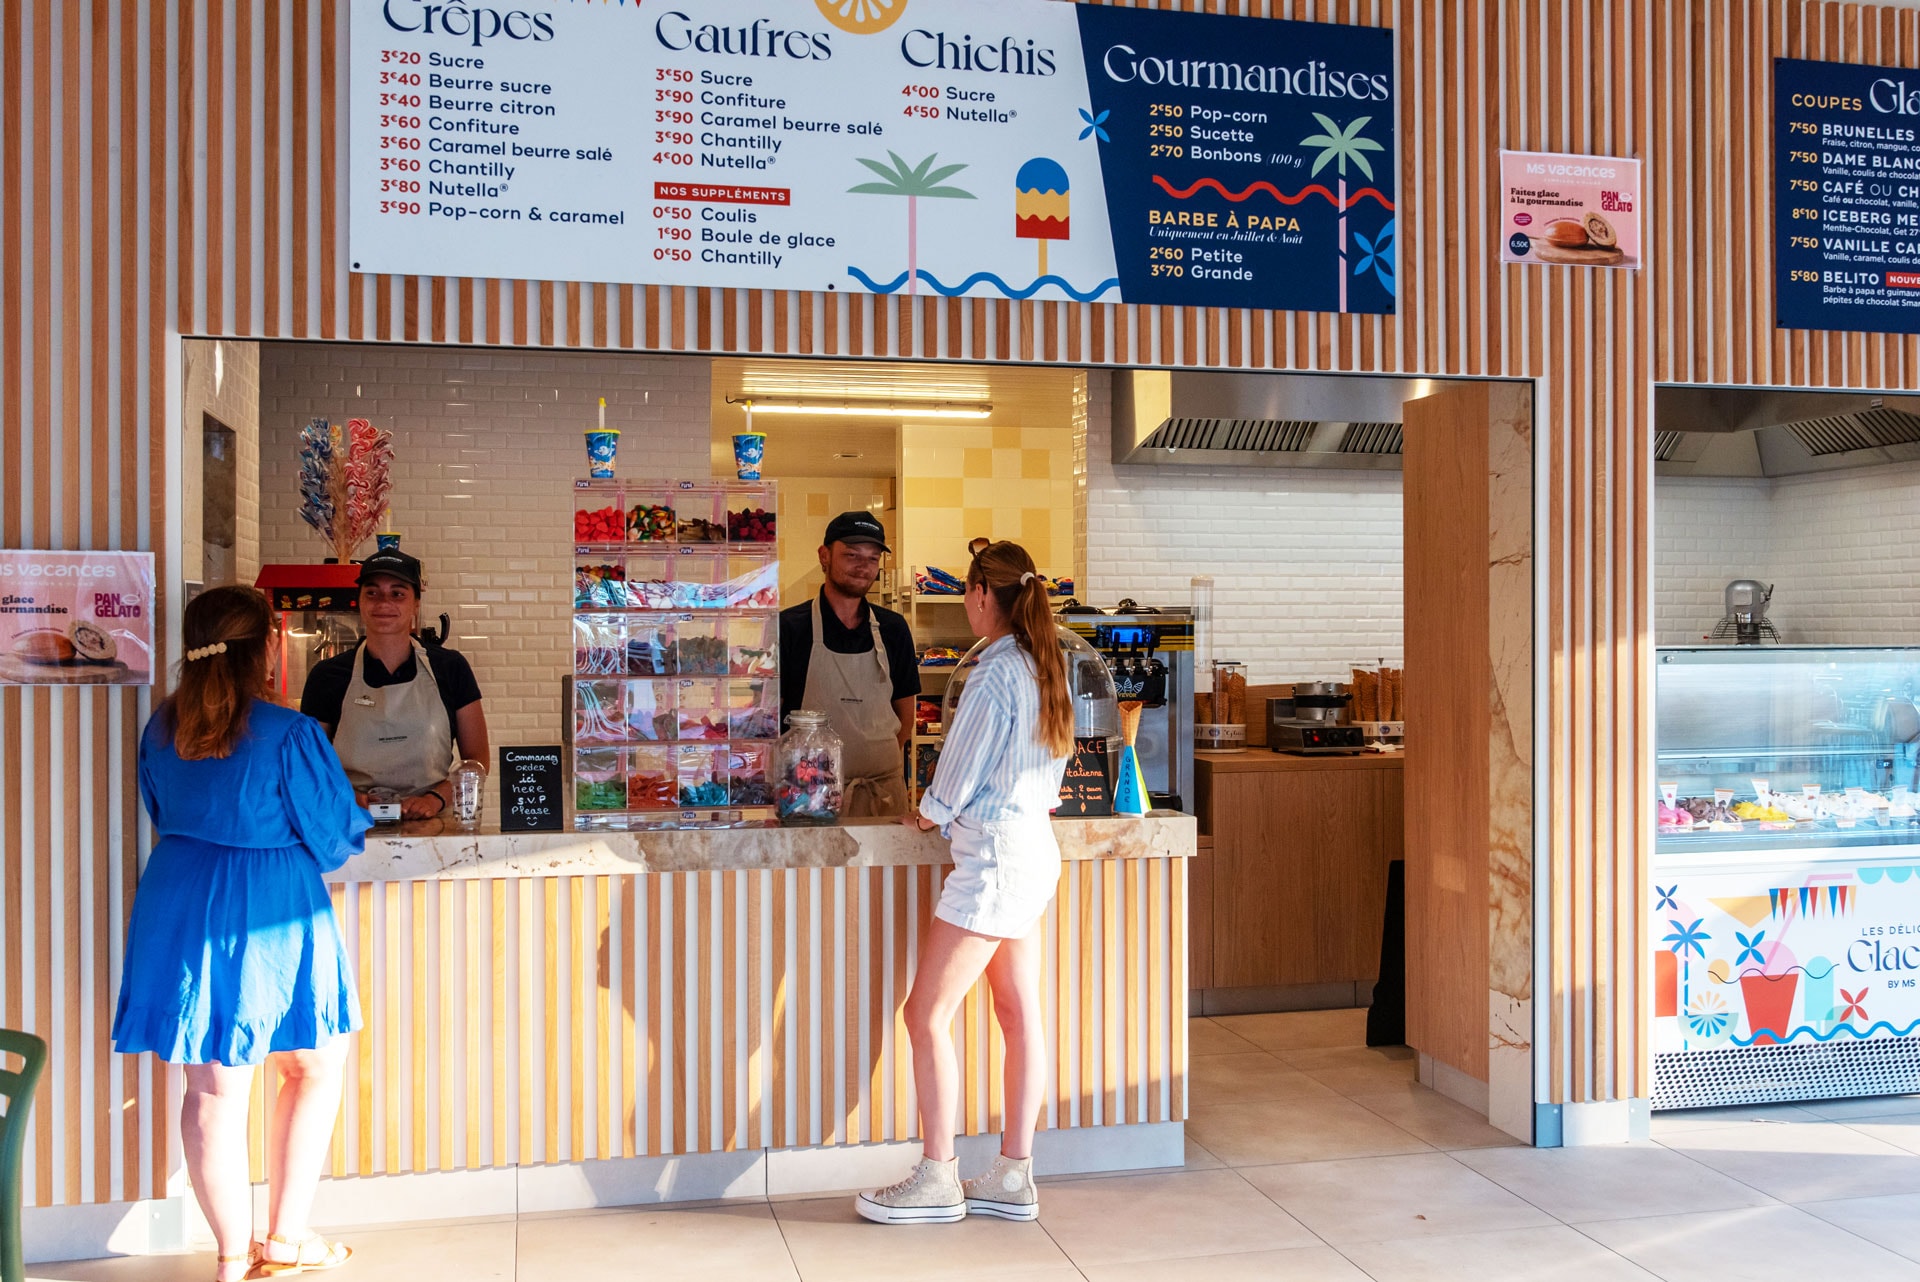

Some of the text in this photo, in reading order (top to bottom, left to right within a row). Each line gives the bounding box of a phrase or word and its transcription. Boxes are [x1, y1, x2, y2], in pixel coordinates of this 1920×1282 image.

[382, 0, 554, 47] Crêpes
[655, 11, 832, 61] Gaufres
[381, 50, 484, 69] 3€20 Sucre
[900, 29, 1057, 77] Chichis
[655, 68, 753, 87] 3€50 Sucre
[1104, 44, 1389, 101] Gourmandises
[379, 71, 552, 95] 3€40 Beurre sucre
[654, 89, 786, 110] 3€90 Confiture
[901, 85, 996, 103] 4€00 Sucre
[1792, 94, 1862, 111] COUPES
[379, 93, 555, 116] 3€40 Beurre citron
[654, 110, 883, 136] 3€90 Caramel beurre salé
[903, 105, 1017, 124] 4€50 Nutella®
[1149, 104, 1268, 124] 2€50 Pop-corn
[379, 114, 519, 136] 3€60 Confiture
[1149, 124, 1254, 143] 2€50 Sucette
[1790, 122, 1915, 141] 7€50 BRUNELLES
[379, 136, 612, 162] 3€60 Caramel beurre salé
[654, 131, 782, 153] 3€90 Chantilly
[1822, 138, 1848, 148] Fraise,
[1850, 140, 1875, 149] citron,
[1877, 144, 1909, 152] mangue,
[652, 151, 776, 171] 4€00 Nutella®
[1150, 145, 1183, 159] 2€70
[1190, 146, 1262, 163] Bonbons
[1790, 151, 1867, 166] 7€50 DAME
[379, 158, 515, 180] 3€60 Chantilly
[1822, 167, 1850, 176] Vanille,
[379, 179, 509, 198] 3€80 Nutella®
[660, 186, 786, 201] NOS SUPPLÉMENTS
[1510, 188, 1560, 198] Faites glace
[1601, 191, 1618, 201] PAN
[1790, 179, 1919, 198] 7€50 CAFÉ OU CH
[1526, 198, 1584, 207] gourmandise
[1602, 202, 1632, 212] GELATO
[1822, 195, 1840, 203] Café
[1855, 197, 1890, 207] chocolat,
[1892, 200, 1919, 208] vanille,
[379, 201, 624, 225] 3€90 Pop-corn & caramel
[653, 206, 757, 224] 0€50 Coulis
[1149, 210, 1300, 232] BARBE À PAPA
[1792, 208, 1818, 220] 8€10
[1823, 209, 1891, 224] ICEBERG
[657, 227, 836, 250] 1€90 Boule de glace
[1149, 227, 1303, 245] Uniquement en Juillet & Août
[1823, 224, 1891, 235] Menthe-Chocolat,
[1511, 239, 1529, 249] 6,50€
[1790, 237, 1818, 249] 7€50
[1823, 238, 1890, 253] VANILLE
[653, 248, 782, 269] 0€50 Chantilly
[1149, 247, 1243, 263] 2€60 Petite
[1823, 252, 1851, 262] Vanille,
[1853, 255, 1886, 264] caramel,
[1151, 264, 1253, 281] 3€70 Grande
[1790, 270, 1818, 282] 5€80
[1823, 271, 1879, 284] BELITO
[1823, 285, 1846, 294] Barbe
[1823, 296, 1852, 305] pépites
[1866, 298, 1900, 306] chocolat
[2, 595, 34, 605] glace
[95, 593, 121, 605] PAN
[95, 606, 141, 618] GELATO
[1078, 740, 1105, 754] ACE
[519, 773, 536, 783] ici
[1861, 926, 1884, 936] LES
[1902, 979, 1916, 988] MS
